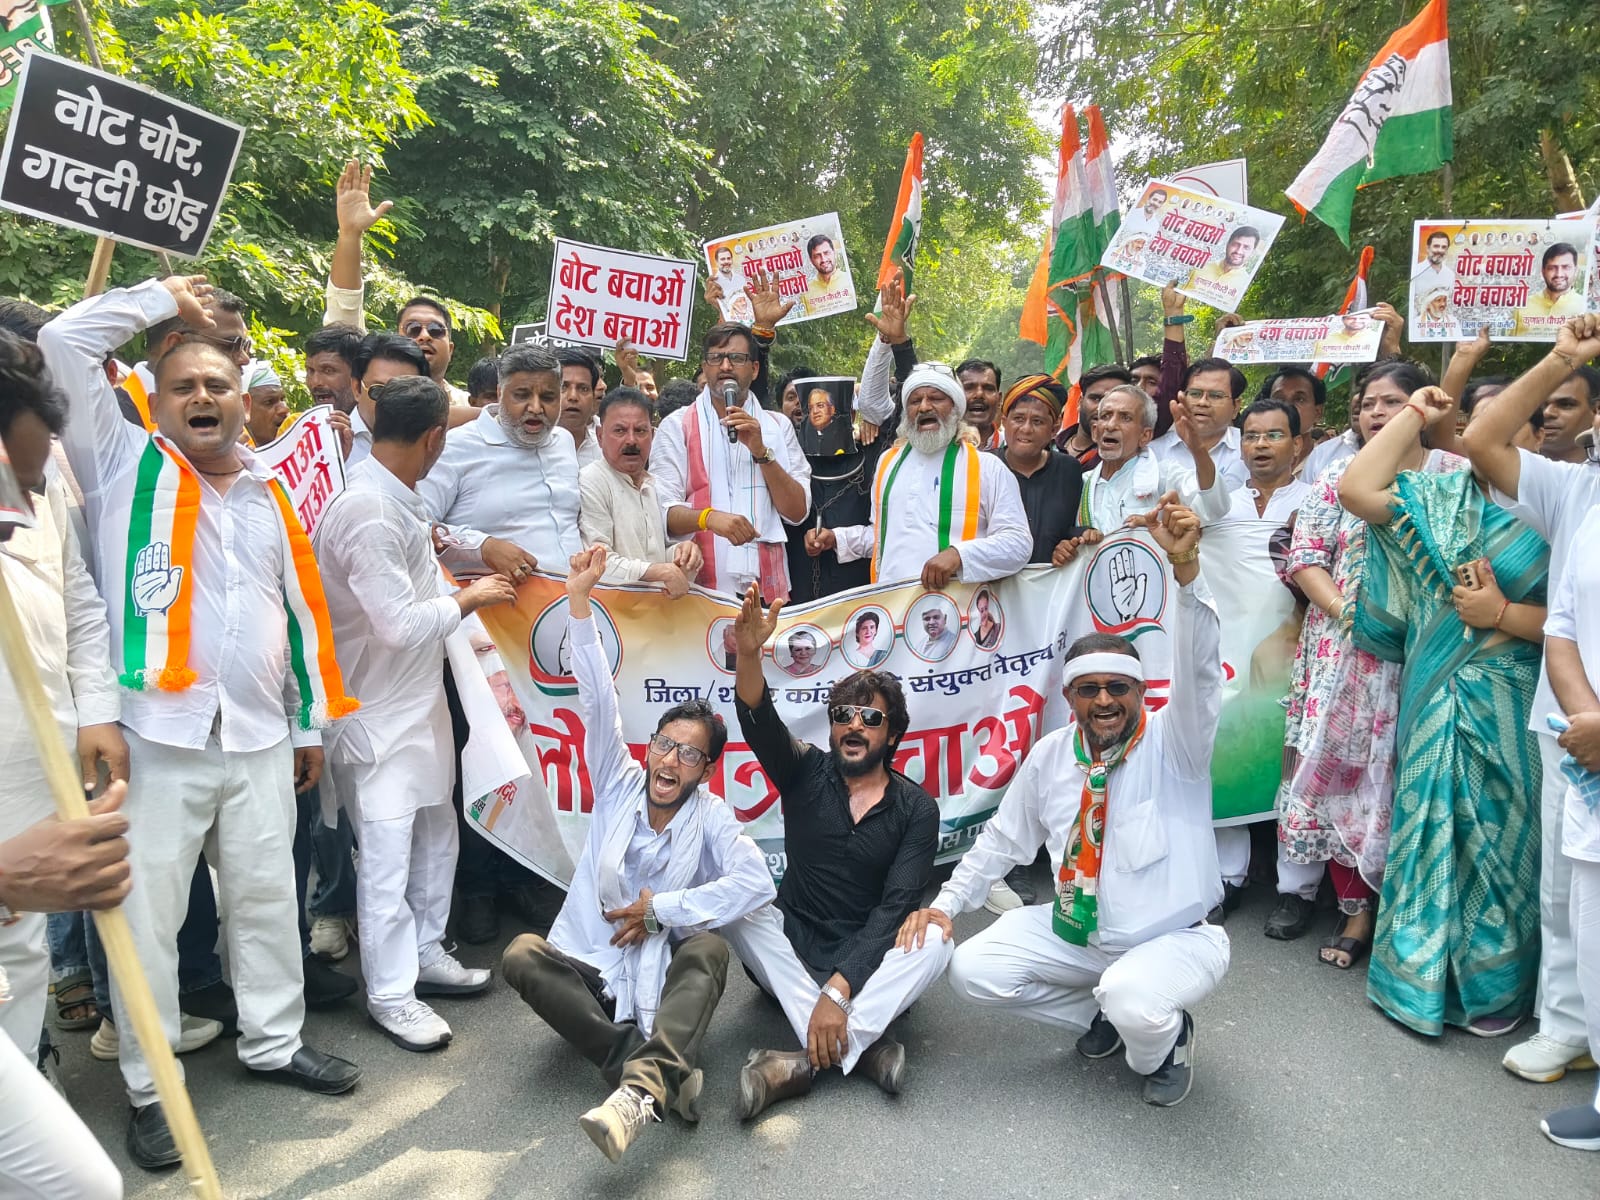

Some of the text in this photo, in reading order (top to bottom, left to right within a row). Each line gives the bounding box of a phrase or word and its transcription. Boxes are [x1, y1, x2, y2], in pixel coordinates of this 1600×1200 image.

[54, 85, 204, 177] वोट चोर,
[22, 144, 208, 243] गद्दी छोड़
[1161, 208, 1227, 246] वोट बचाओ
[742, 245, 804, 279] वोट बचाओ
[1148, 230, 1174, 257] देश
[1170, 242, 1213, 269] बचाओ
[1456, 248, 1536, 277] वोट बचाओ
[559, 251, 687, 308] बोट बचाओं
[772, 271, 809, 297] चाओ
[1453, 280, 1530, 308] देश बचाओ
[555, 294, 682, 350] देश बचाओं
[1285, 323, 1330, 340] बचाओ
[644, 678, 700, 703] जिला
[908, 668, 992, 696] संयुक्त
[993, 642, 1055, 677] नेतृत्व
